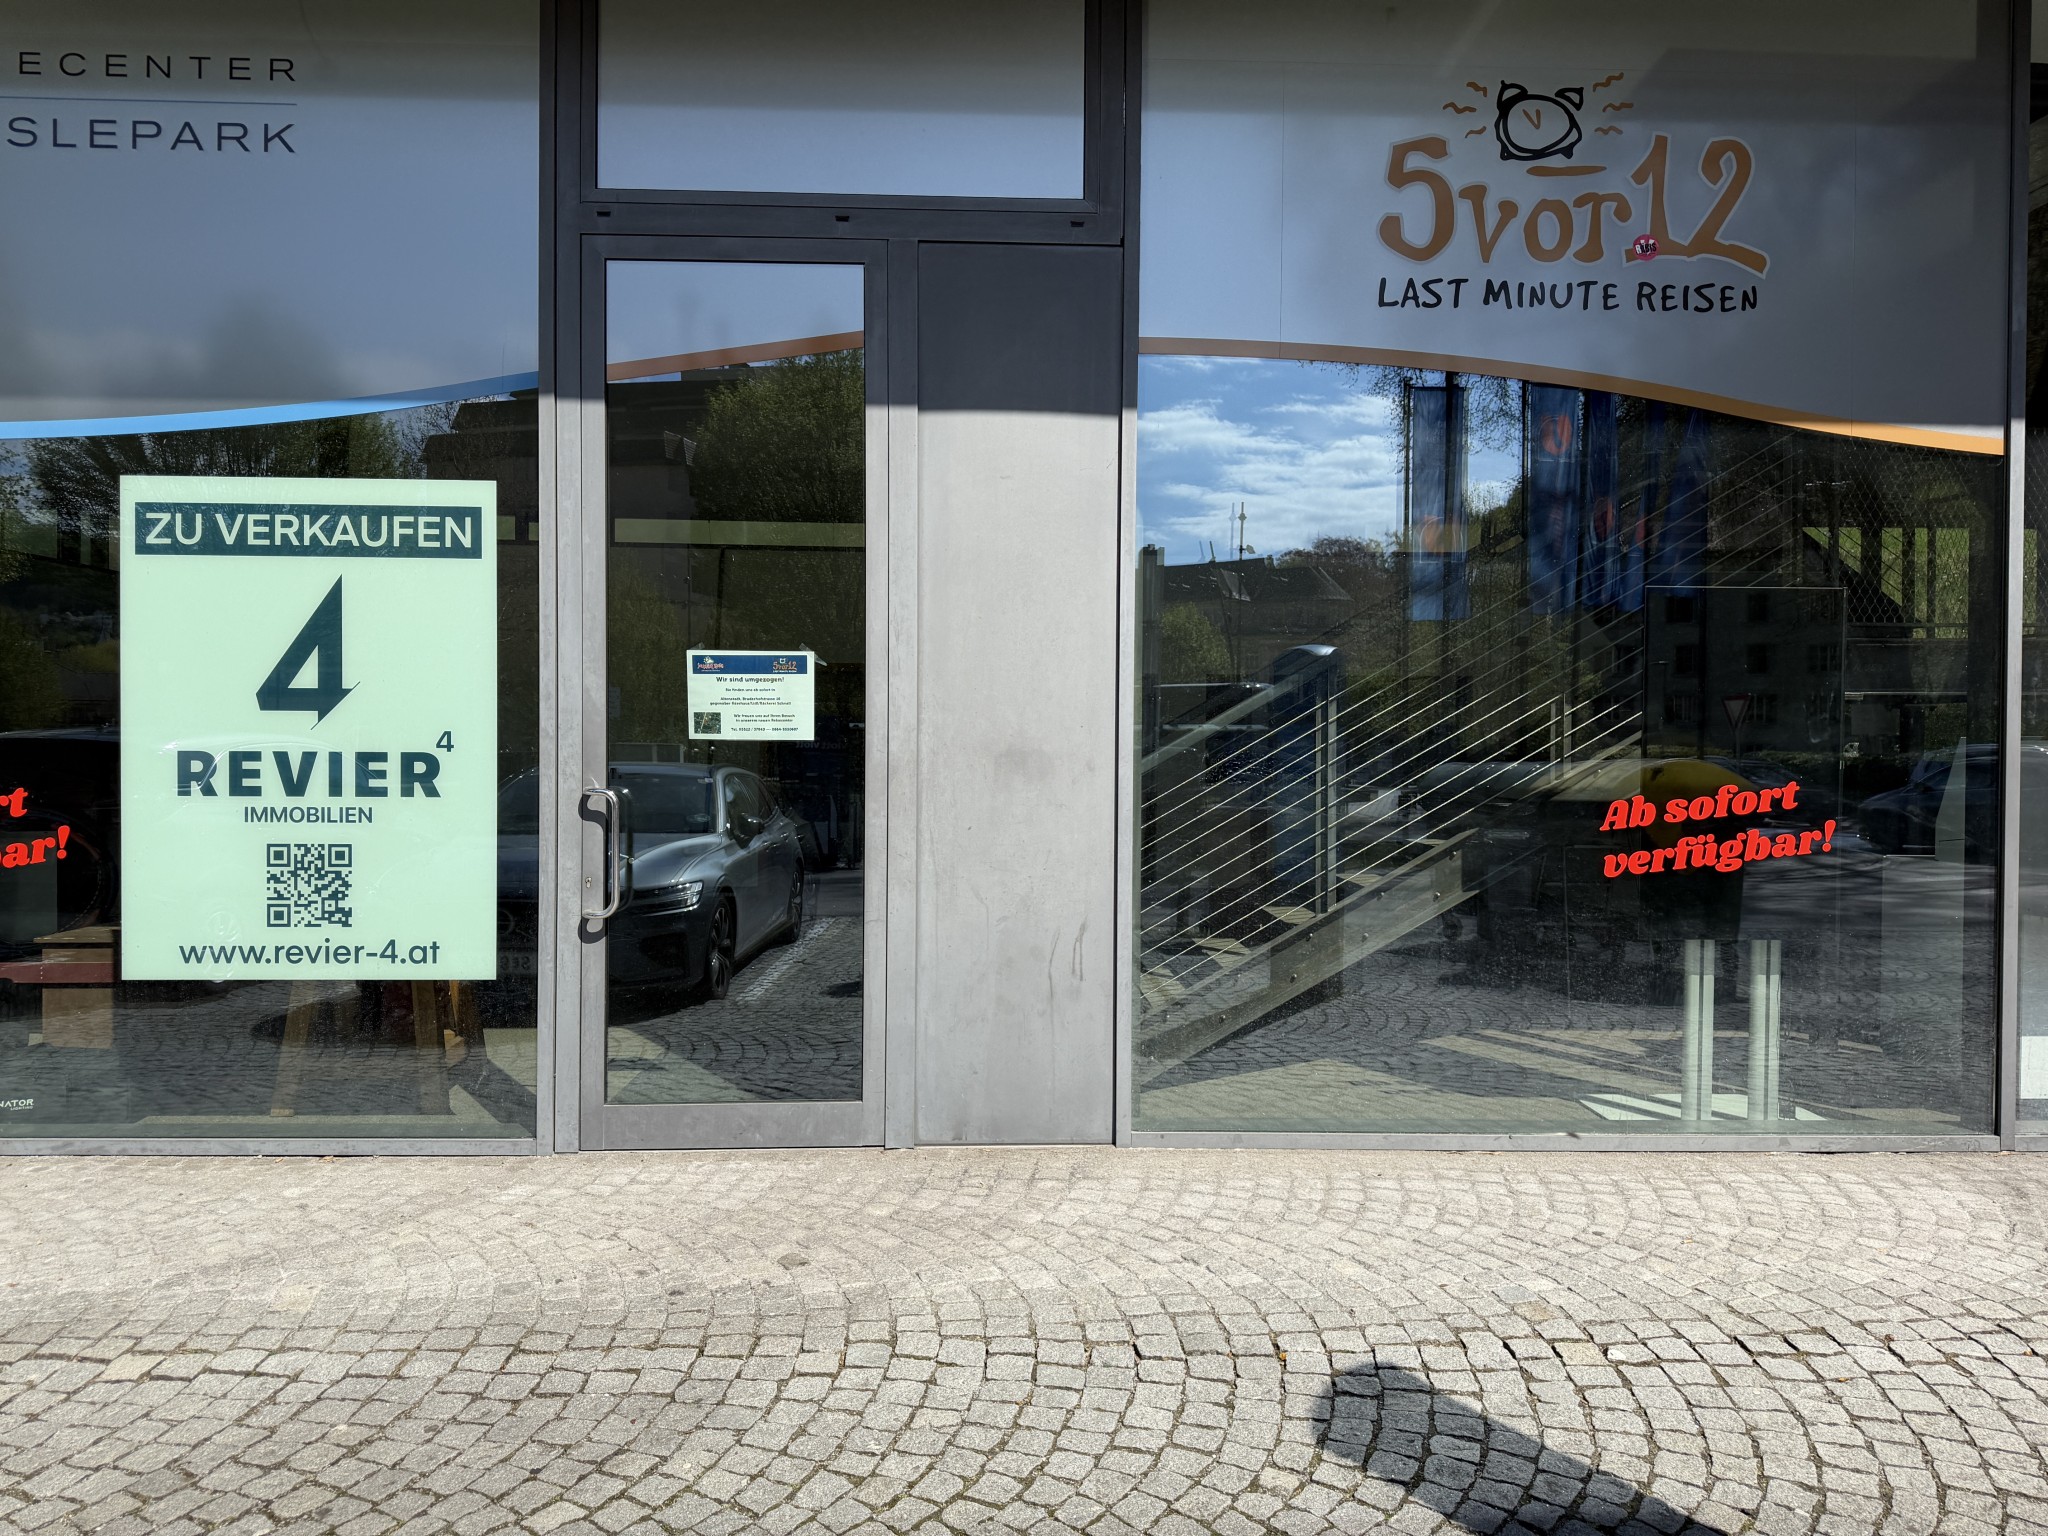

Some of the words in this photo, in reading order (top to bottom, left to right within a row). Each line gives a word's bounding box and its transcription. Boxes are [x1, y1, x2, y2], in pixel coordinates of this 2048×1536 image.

[17, 51, 297, 83] ECENTER
[6, 116, 297, 154] SLEPARK
[1378, 276, 1469, 309] LAST
[1483, 279, 1621, 311] MINUTE
[1636, 281, 1759, 313] REISEN
[144, 511, 203, 546] ZU
[214, 512, 474, 549] VERKAUFEN
[745, 676, 785, 684] umgezogen!
[176, 749, 442, 798] REVIER
[435, 730, 455, 753] 4
[243, 805, 374, 825] IMMOBILIEN
[1599, 794, 1657, 831] Ab
[1663, 781, 1801, 823] sofort
[1602, 819, 1837, 878] verfügbar!
[178, 938, 441, 965] www.revier-4.at
